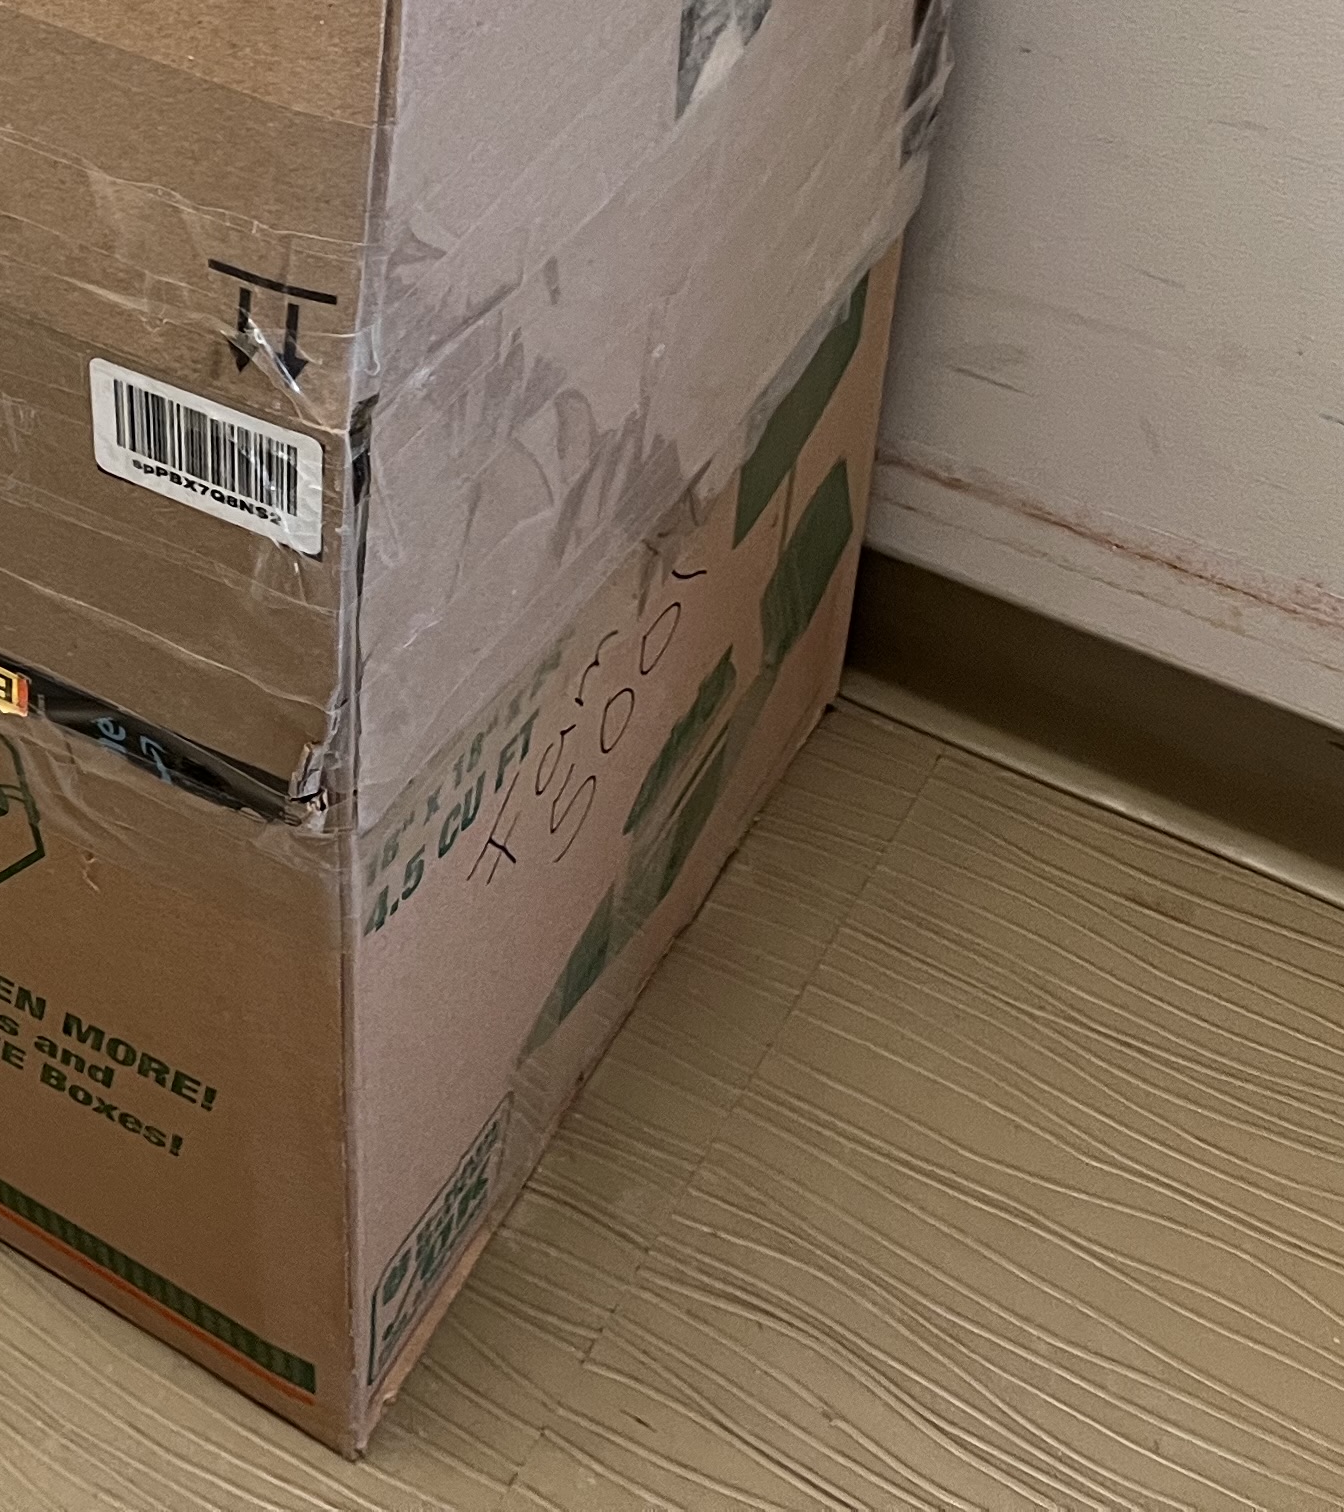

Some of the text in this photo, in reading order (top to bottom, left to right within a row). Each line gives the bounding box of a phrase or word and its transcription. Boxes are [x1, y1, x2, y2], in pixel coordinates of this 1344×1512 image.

[363, 707, 540, 938] 4.5 CU FT
[33, 1034, 115, 1090] and
[39, 1061, 185, 1158] Boxes!
[62, 1011, 218, 1113] MORE!
